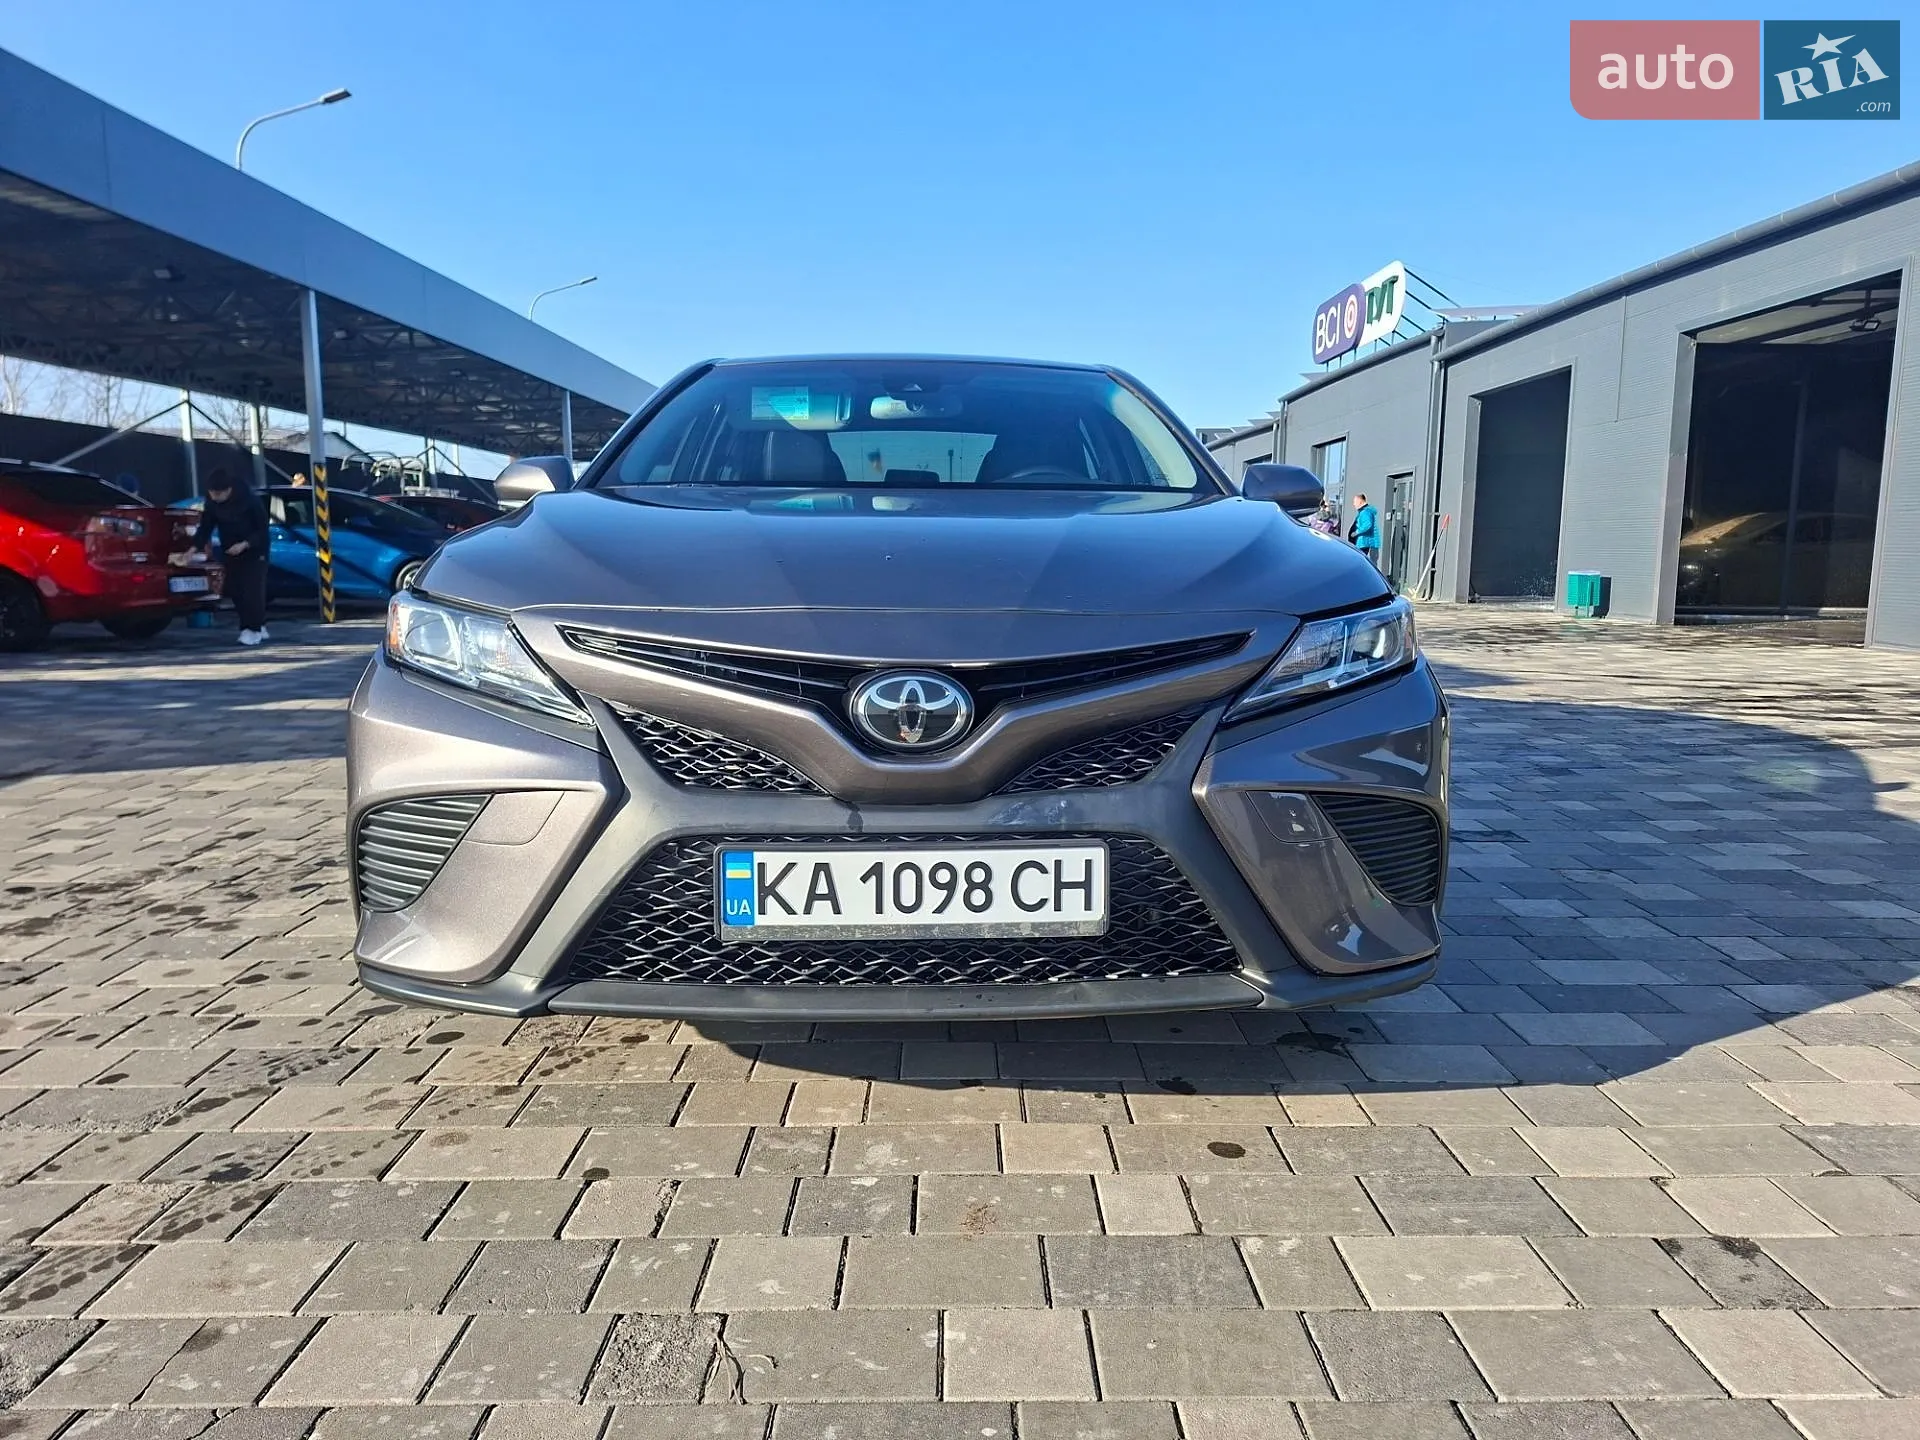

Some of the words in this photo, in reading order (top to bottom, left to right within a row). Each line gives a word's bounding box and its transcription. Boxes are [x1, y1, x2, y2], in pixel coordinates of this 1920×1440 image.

[757, 861, 842, 916] KA
[859, 861, 993, 915] 1098
[1010, 858, 1093, 913] CH
[726, 899, 752, 917] UA
